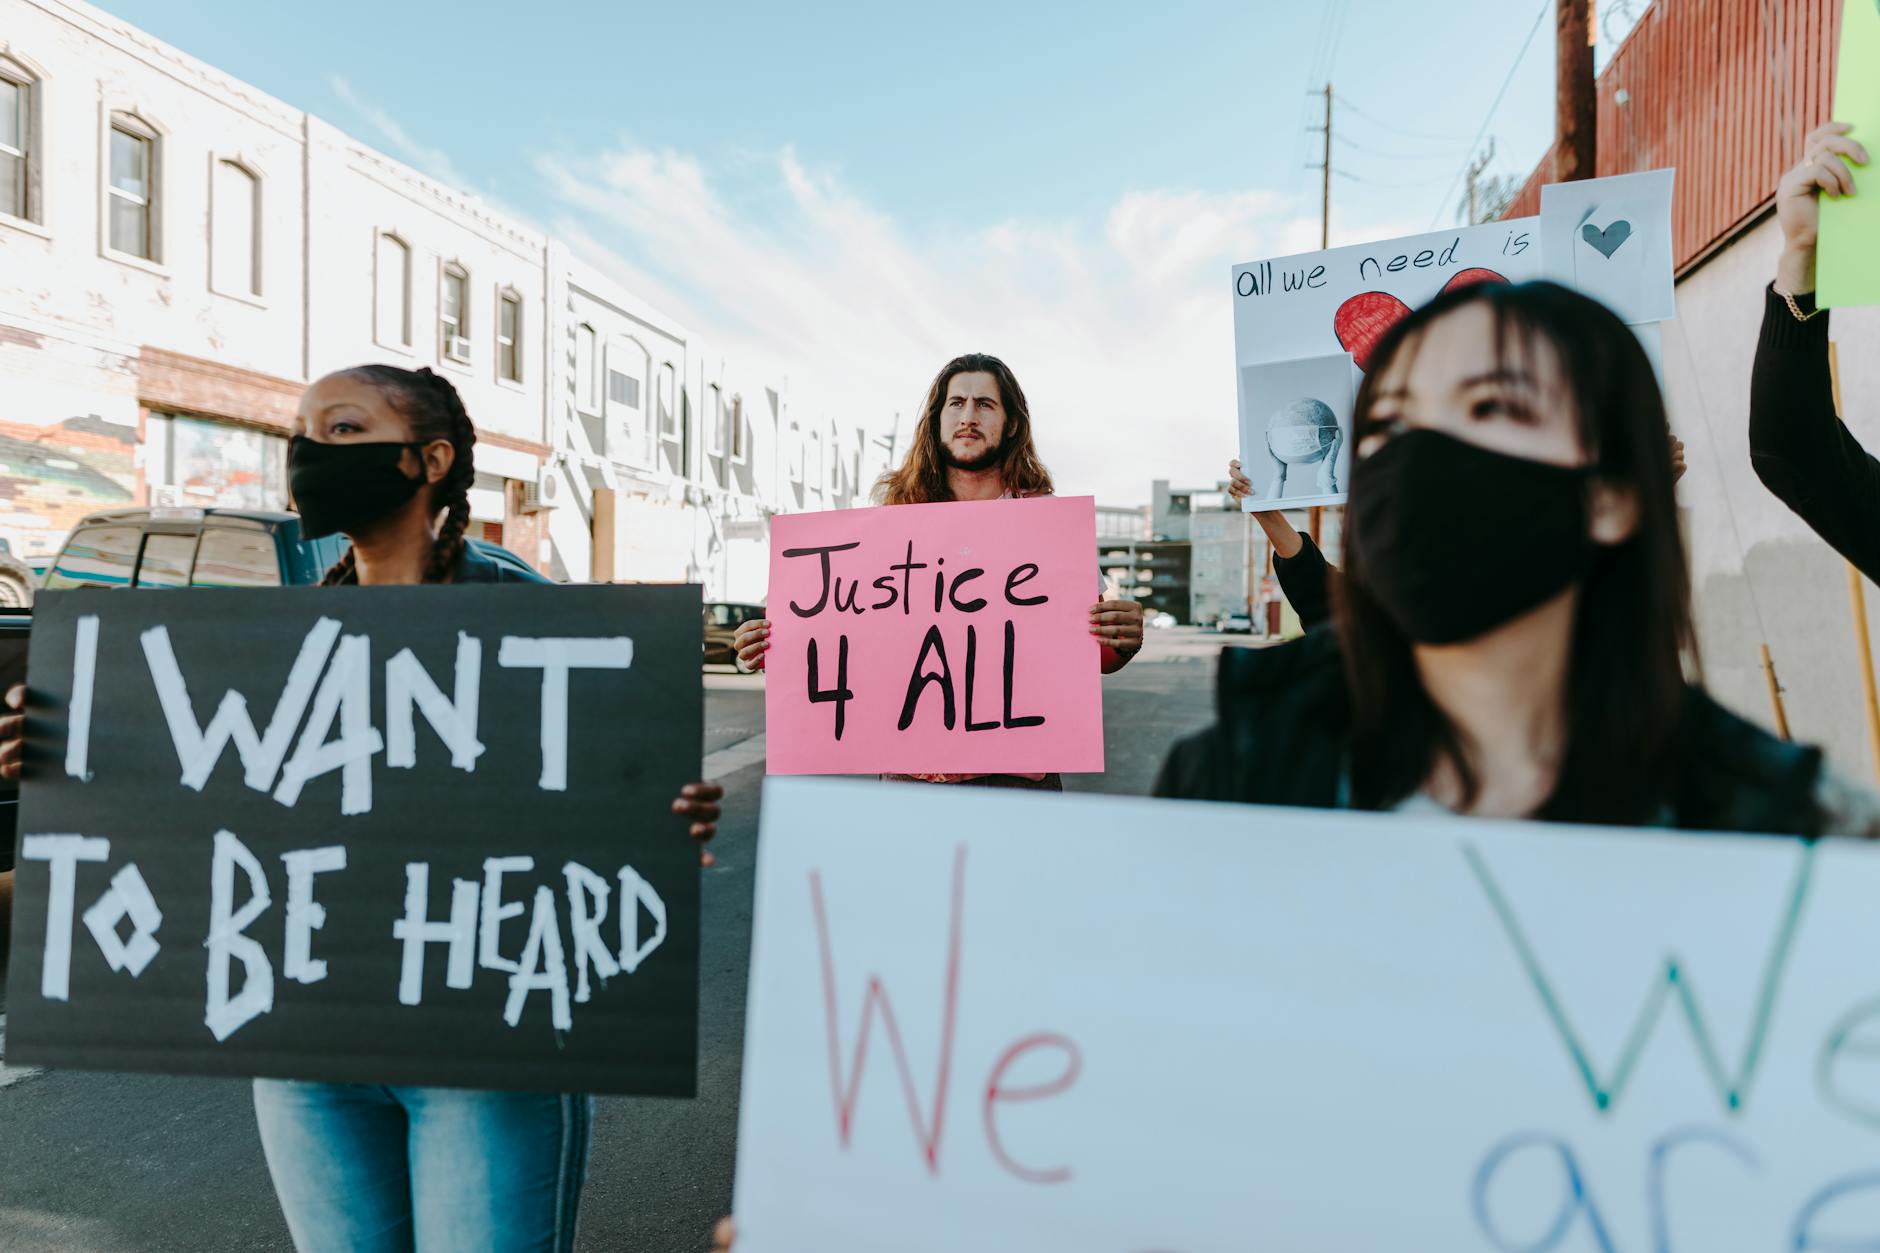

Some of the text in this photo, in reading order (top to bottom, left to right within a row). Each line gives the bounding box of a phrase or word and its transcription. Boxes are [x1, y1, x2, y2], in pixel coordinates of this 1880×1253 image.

[1236, 230, 1531, 297] all we need is
[782, 539, 1049, 618] Justice
[65, 615, 634, 815] I WANT
[807, 619, 1045, 741] 4 ALL
[22, 829, 667, 1041] TO BE HEARD
[808, 844, 1082, 1183] We
